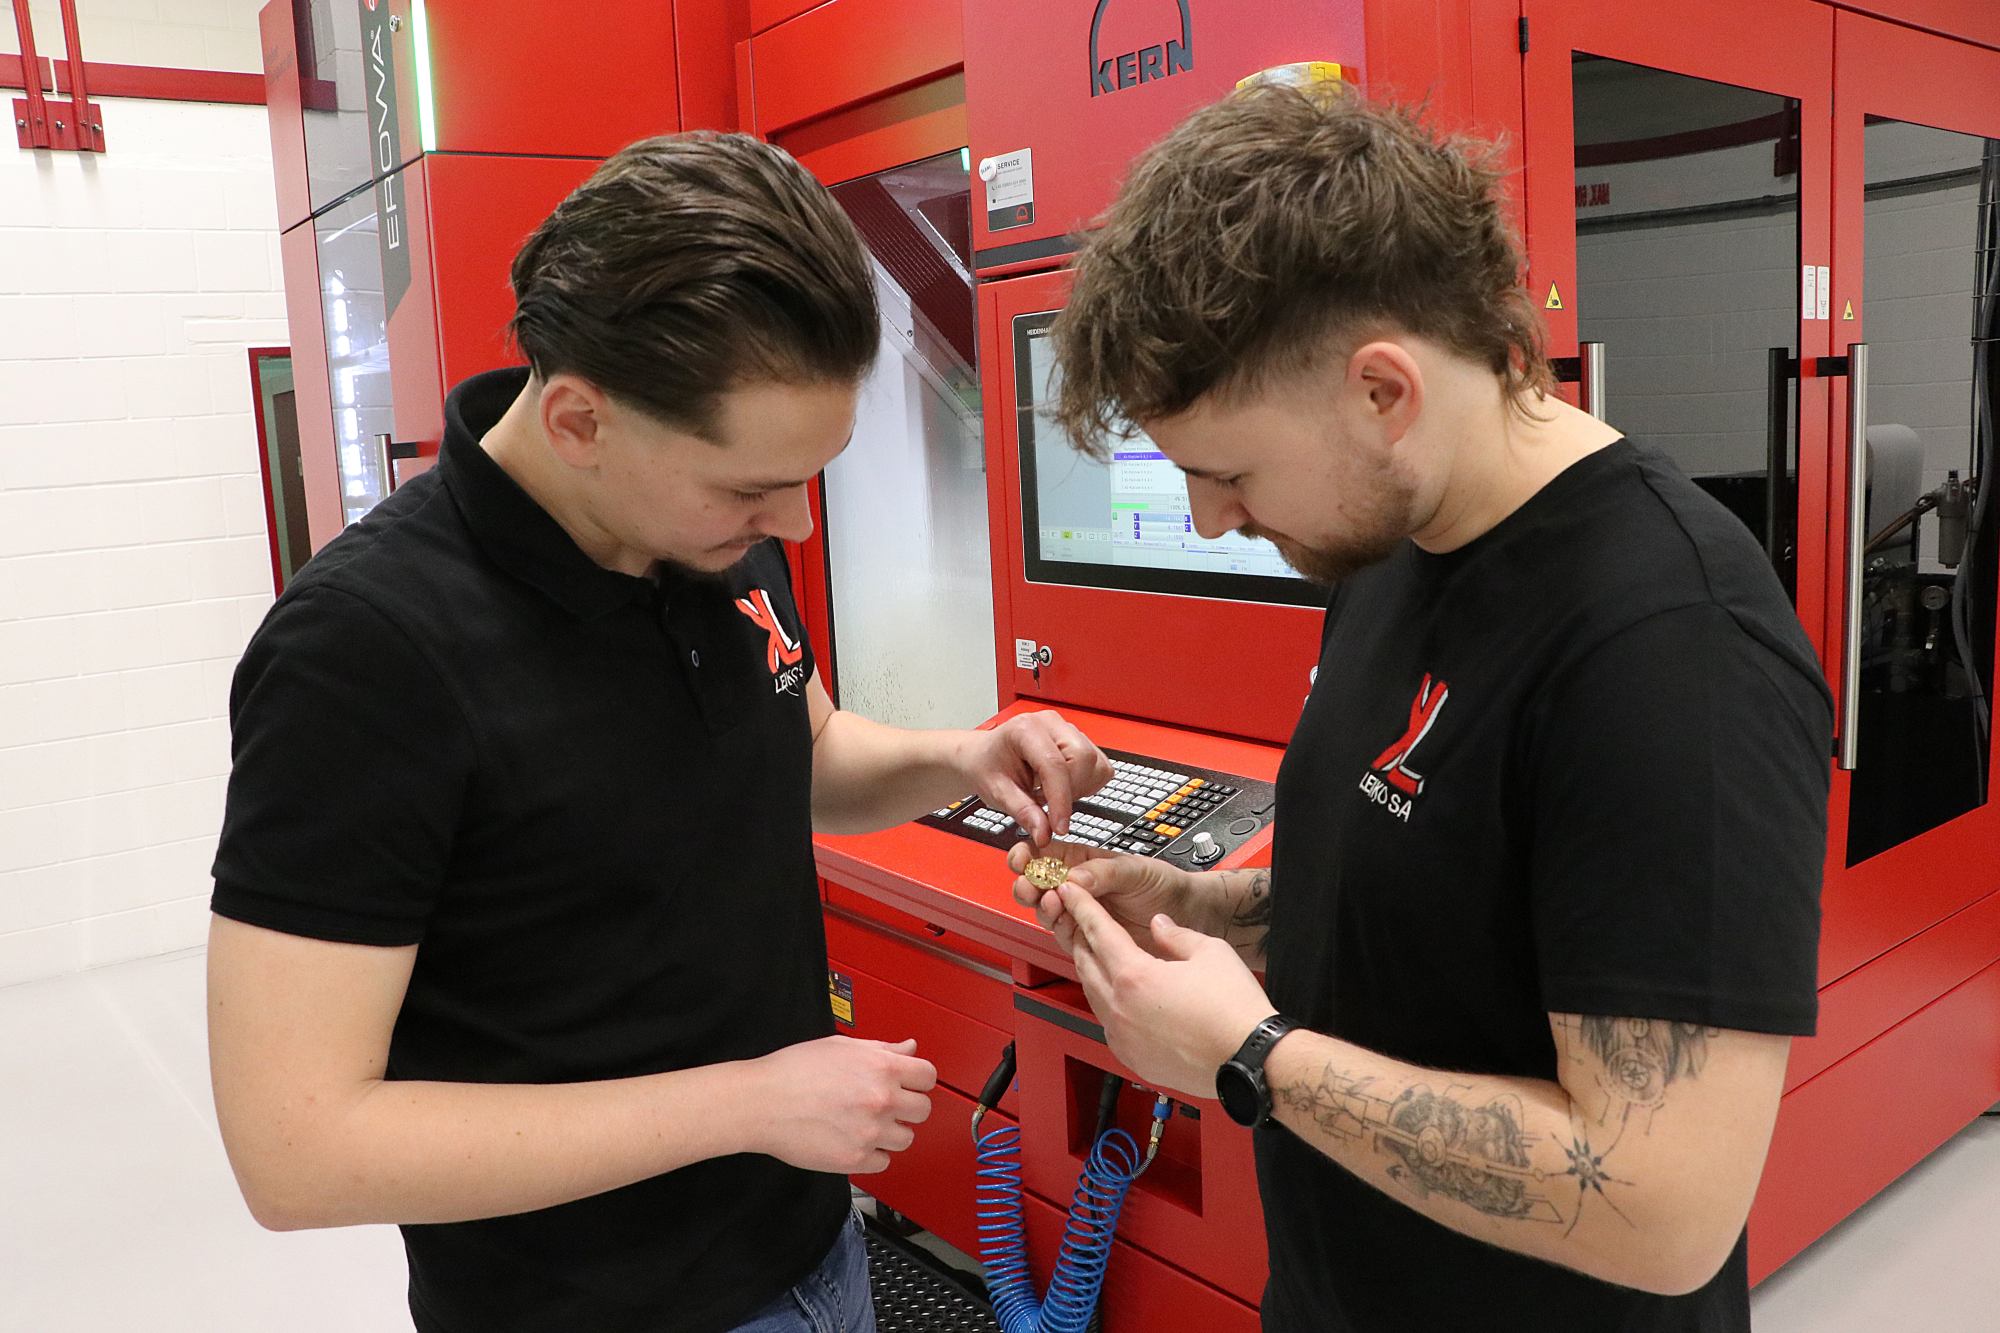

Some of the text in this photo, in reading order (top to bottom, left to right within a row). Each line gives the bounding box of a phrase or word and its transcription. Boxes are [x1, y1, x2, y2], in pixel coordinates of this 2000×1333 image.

[1089, 39, 1193, 97] KERN
[371, 24, 400, 250] EROWA
[997, 158, 1020, 170] SERVICE
[1358, 771, 1412, 822] LEIKO SA
